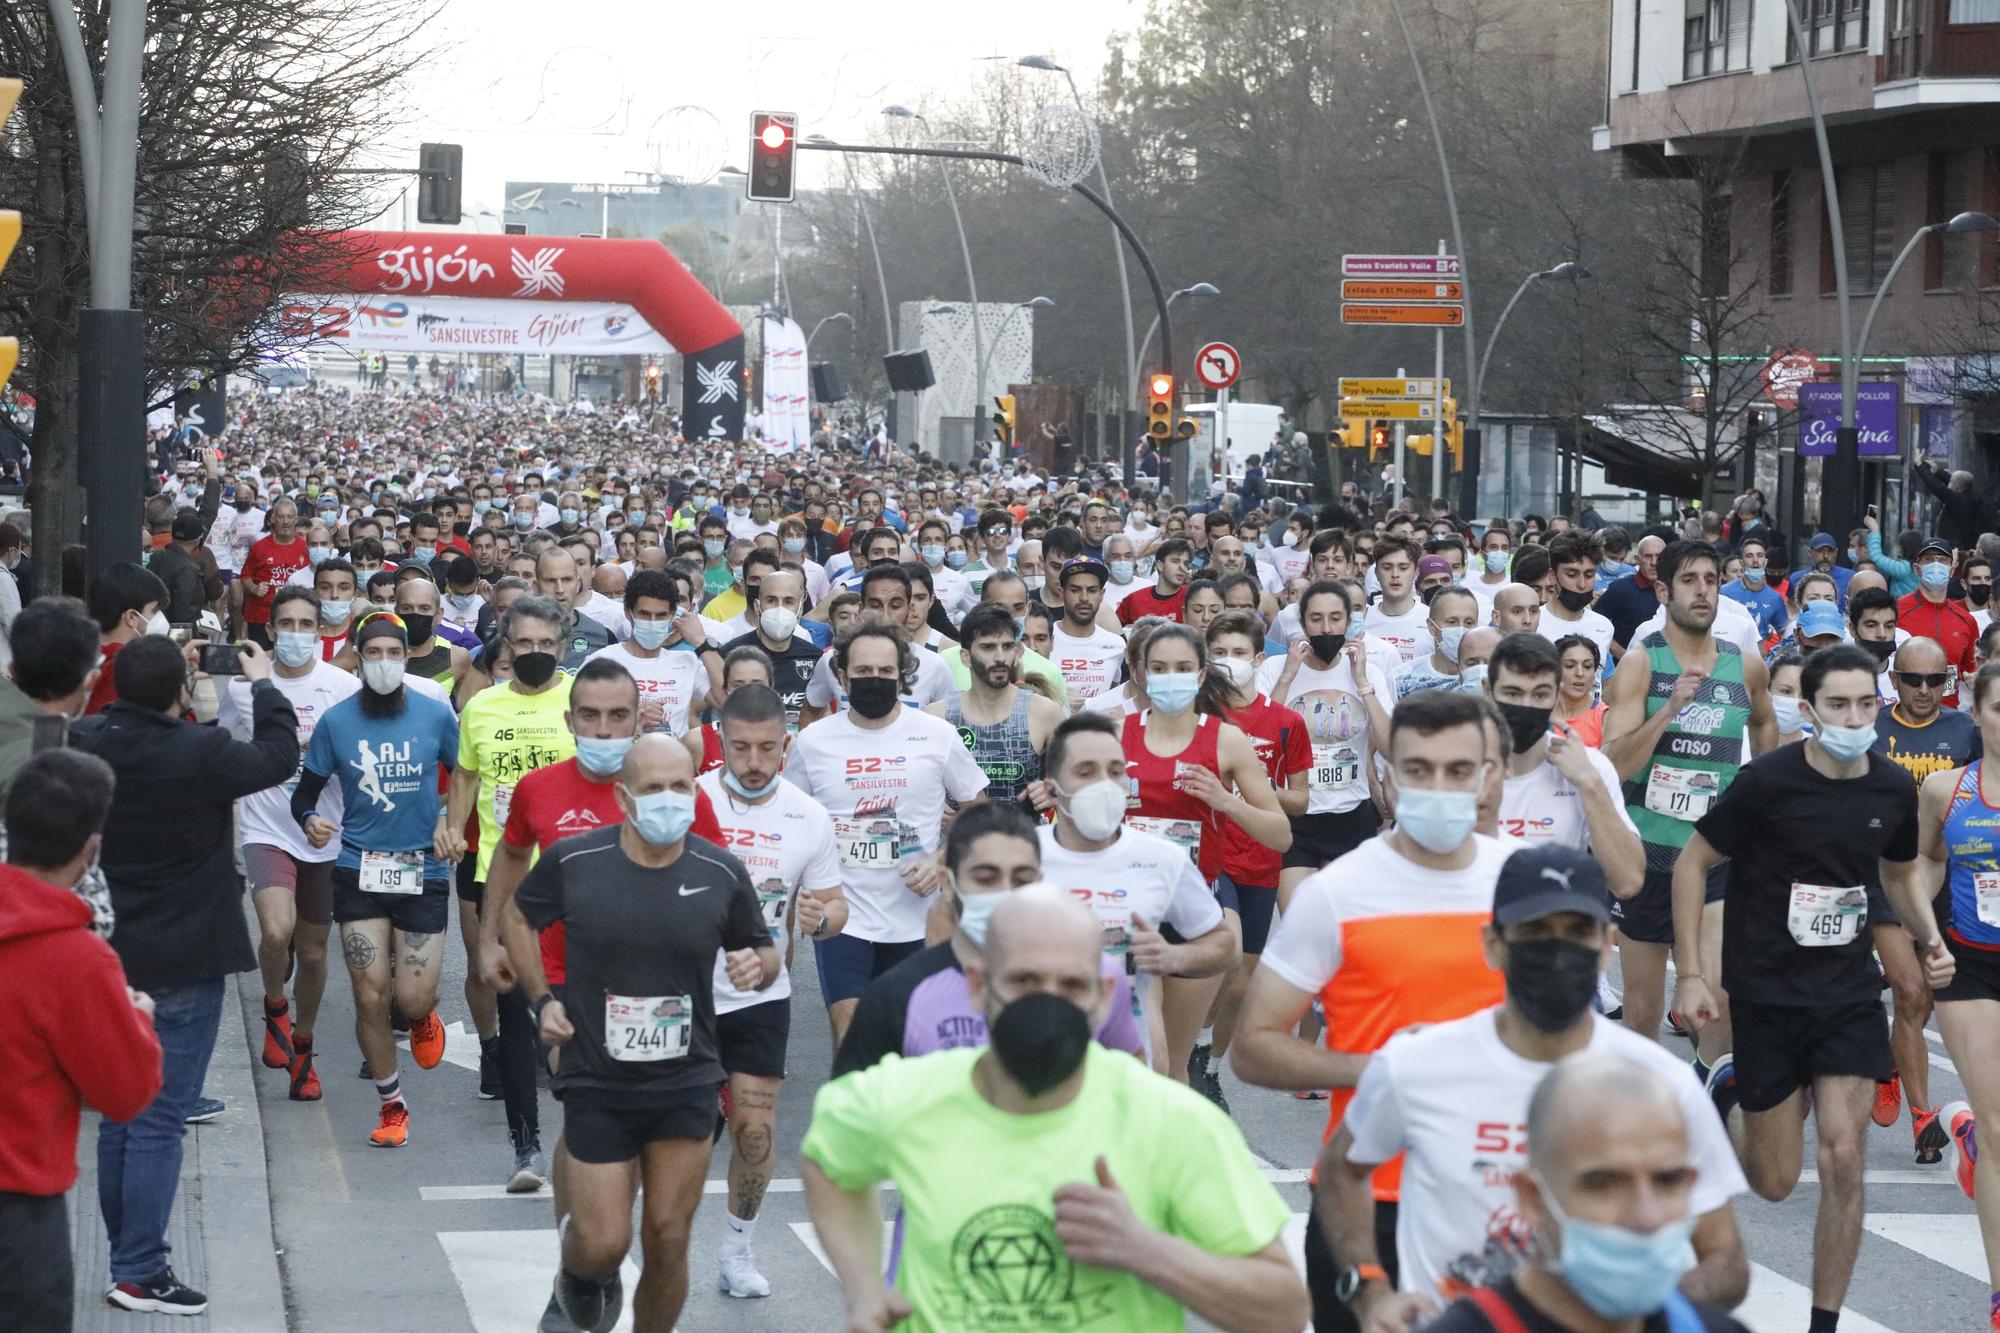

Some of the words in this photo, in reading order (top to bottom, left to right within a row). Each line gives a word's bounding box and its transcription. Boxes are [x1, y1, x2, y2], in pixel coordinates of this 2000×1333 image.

[377, 244, 496, 293] gijón
[429, 327, 519, 345] SANSILVESTRE
[527, 312, 587, 347] Gijón
[1857, 392, 1891, 400] POLLOS
[1371, 409, 1391, 417] Viejo
[1804, 420, 1893, 446] Saina
[1061, 659, 1088, 671] 52
[1065, 675, 1105, 683] SANSILVESTRE
[494, 728, 514, 741] 46
[516, 727, 558, 735] SANSILVESTRE
[380, 741, 411, 763] AJ
[1672, 739, 1712, 756] cnso
[376, 762, 423, 778] TEAM
[845, 757, 882, 775] 52
[1318, 767, 1343, 783] 1818
[1653, 770, 1671, 781] 52
[850, 778, 908, 791] SANSILVESTRE
[1670, 792, 1691, 812] 171
[835, 823, 850, 832] 52
[849, 841, 878, 860] 470
[379, 869, 402, 886] 139
[1979, 880, 1998, 889] 52
[1795, 891, 1817, 903] 52
[1810, 914, 1844, 935] 469
[609, 1004, 631, 1015] 52
[625, 1026, 668, 1050] 2441
